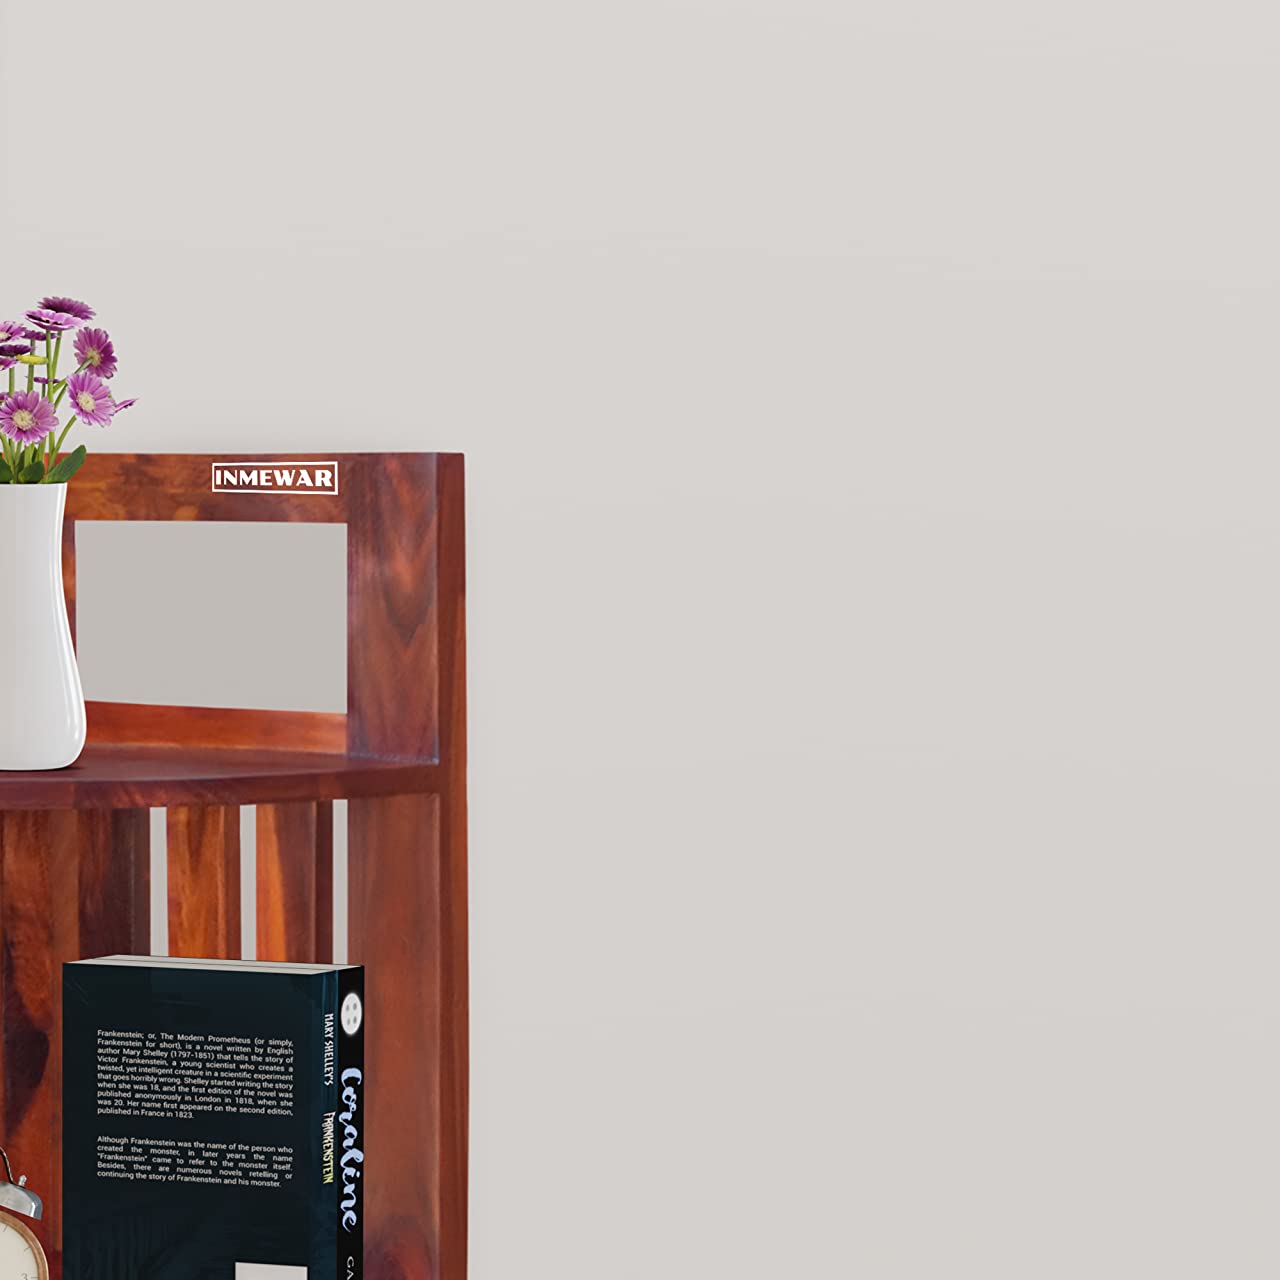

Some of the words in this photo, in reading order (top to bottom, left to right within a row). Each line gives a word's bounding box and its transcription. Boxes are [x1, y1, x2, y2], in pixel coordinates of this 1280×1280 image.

[215, 469, 333, 487] INMEWAR
[324, 1013, 334, 1038] MARY
[97, 1029, 144, 1040] Frankenstein;
[177, 1033, 204, 1042] Modern
[208, 1035, 251, 1044] Prometheus
[254, 1037, 265, 1045] (or
[268, 1038, 294, 1048] simply,
[97, 1038, 142, 1047] Frankenstein
[159, 1041, 182, 1050] short),
[226, 1045, 251, 1053] written
[254, 1046, 264, 1055] by
[267, 1046, 294, 1056] English
[97, 1055, 118, 1063] Victor
[122, 1056, 168, 1067] Frankenstein,
[180, 1061, 202, 1069] young
[206, 1061, 236, 1069] scientist
[122, 1048, 141, 1057] Mary
[143, 1048, 169, 1059] Shelley
[170, 1050, 215, 1060] (1797-1851)
[265, 1055, 284, 1065] story
[324, 1040, 334, 1086] SHELLEY'S
[97, 1063, 124, 1073] twisted,
[126, 1065, 137, 1074] yet
[138, 1066, 173, 1076] intelligent
[220, 1070, 252, 1079] scientific
[253, 1073, 293, 1081] experiment
[131, 1074, 158, 1084] horribly
[158, 1077, 181, 1085] wrong.
[184, 1077, 209, 1087] Shelley
[210, 1078, 235, 1086] started
[236, 1080, 261, 1090] writing
[275, 1082, 293, 1091] story
[150, 1083, 161, 1092] 18,
[207, 1087, 232, 1095] edition
[97, 1090, 131, 1098] published
[134, 1093, 182, 1102] anonymously
[195, 1094, 221, 1103] London
[235, 1097, 254, 1106] 1818,
[97, 1107, 132, 1115] published
[141, 1108, 165, 1117] France
[179, 1104, 212, 1112] appeared
[267, 1107, 293, 1117] edition,
[97, 1135, 129, 1146] Although
[130, 1137, 176, 1147] Frankenstein
[322, 1111, 336, 1184] FRANKENSTEIN
[150, 1148, 180, 1157] monster,
[202, 1150, 218, 1158] later
[339, 1067, 364, 1233] Coraline
[97, 1152, 148, 1162] "Frankenstein"
[273, 1162, 292, 1171] itself.
[97, 1161, 126, 1171] Besides,
[133, 1163, 152, 1171] there
[249, 1170, 278, 1180] retelling
[97, 1170, 134, 1180] continuing
[148, 1173, 166, 1182] story
[176, 1174, 222, 1184] Frankenstein
